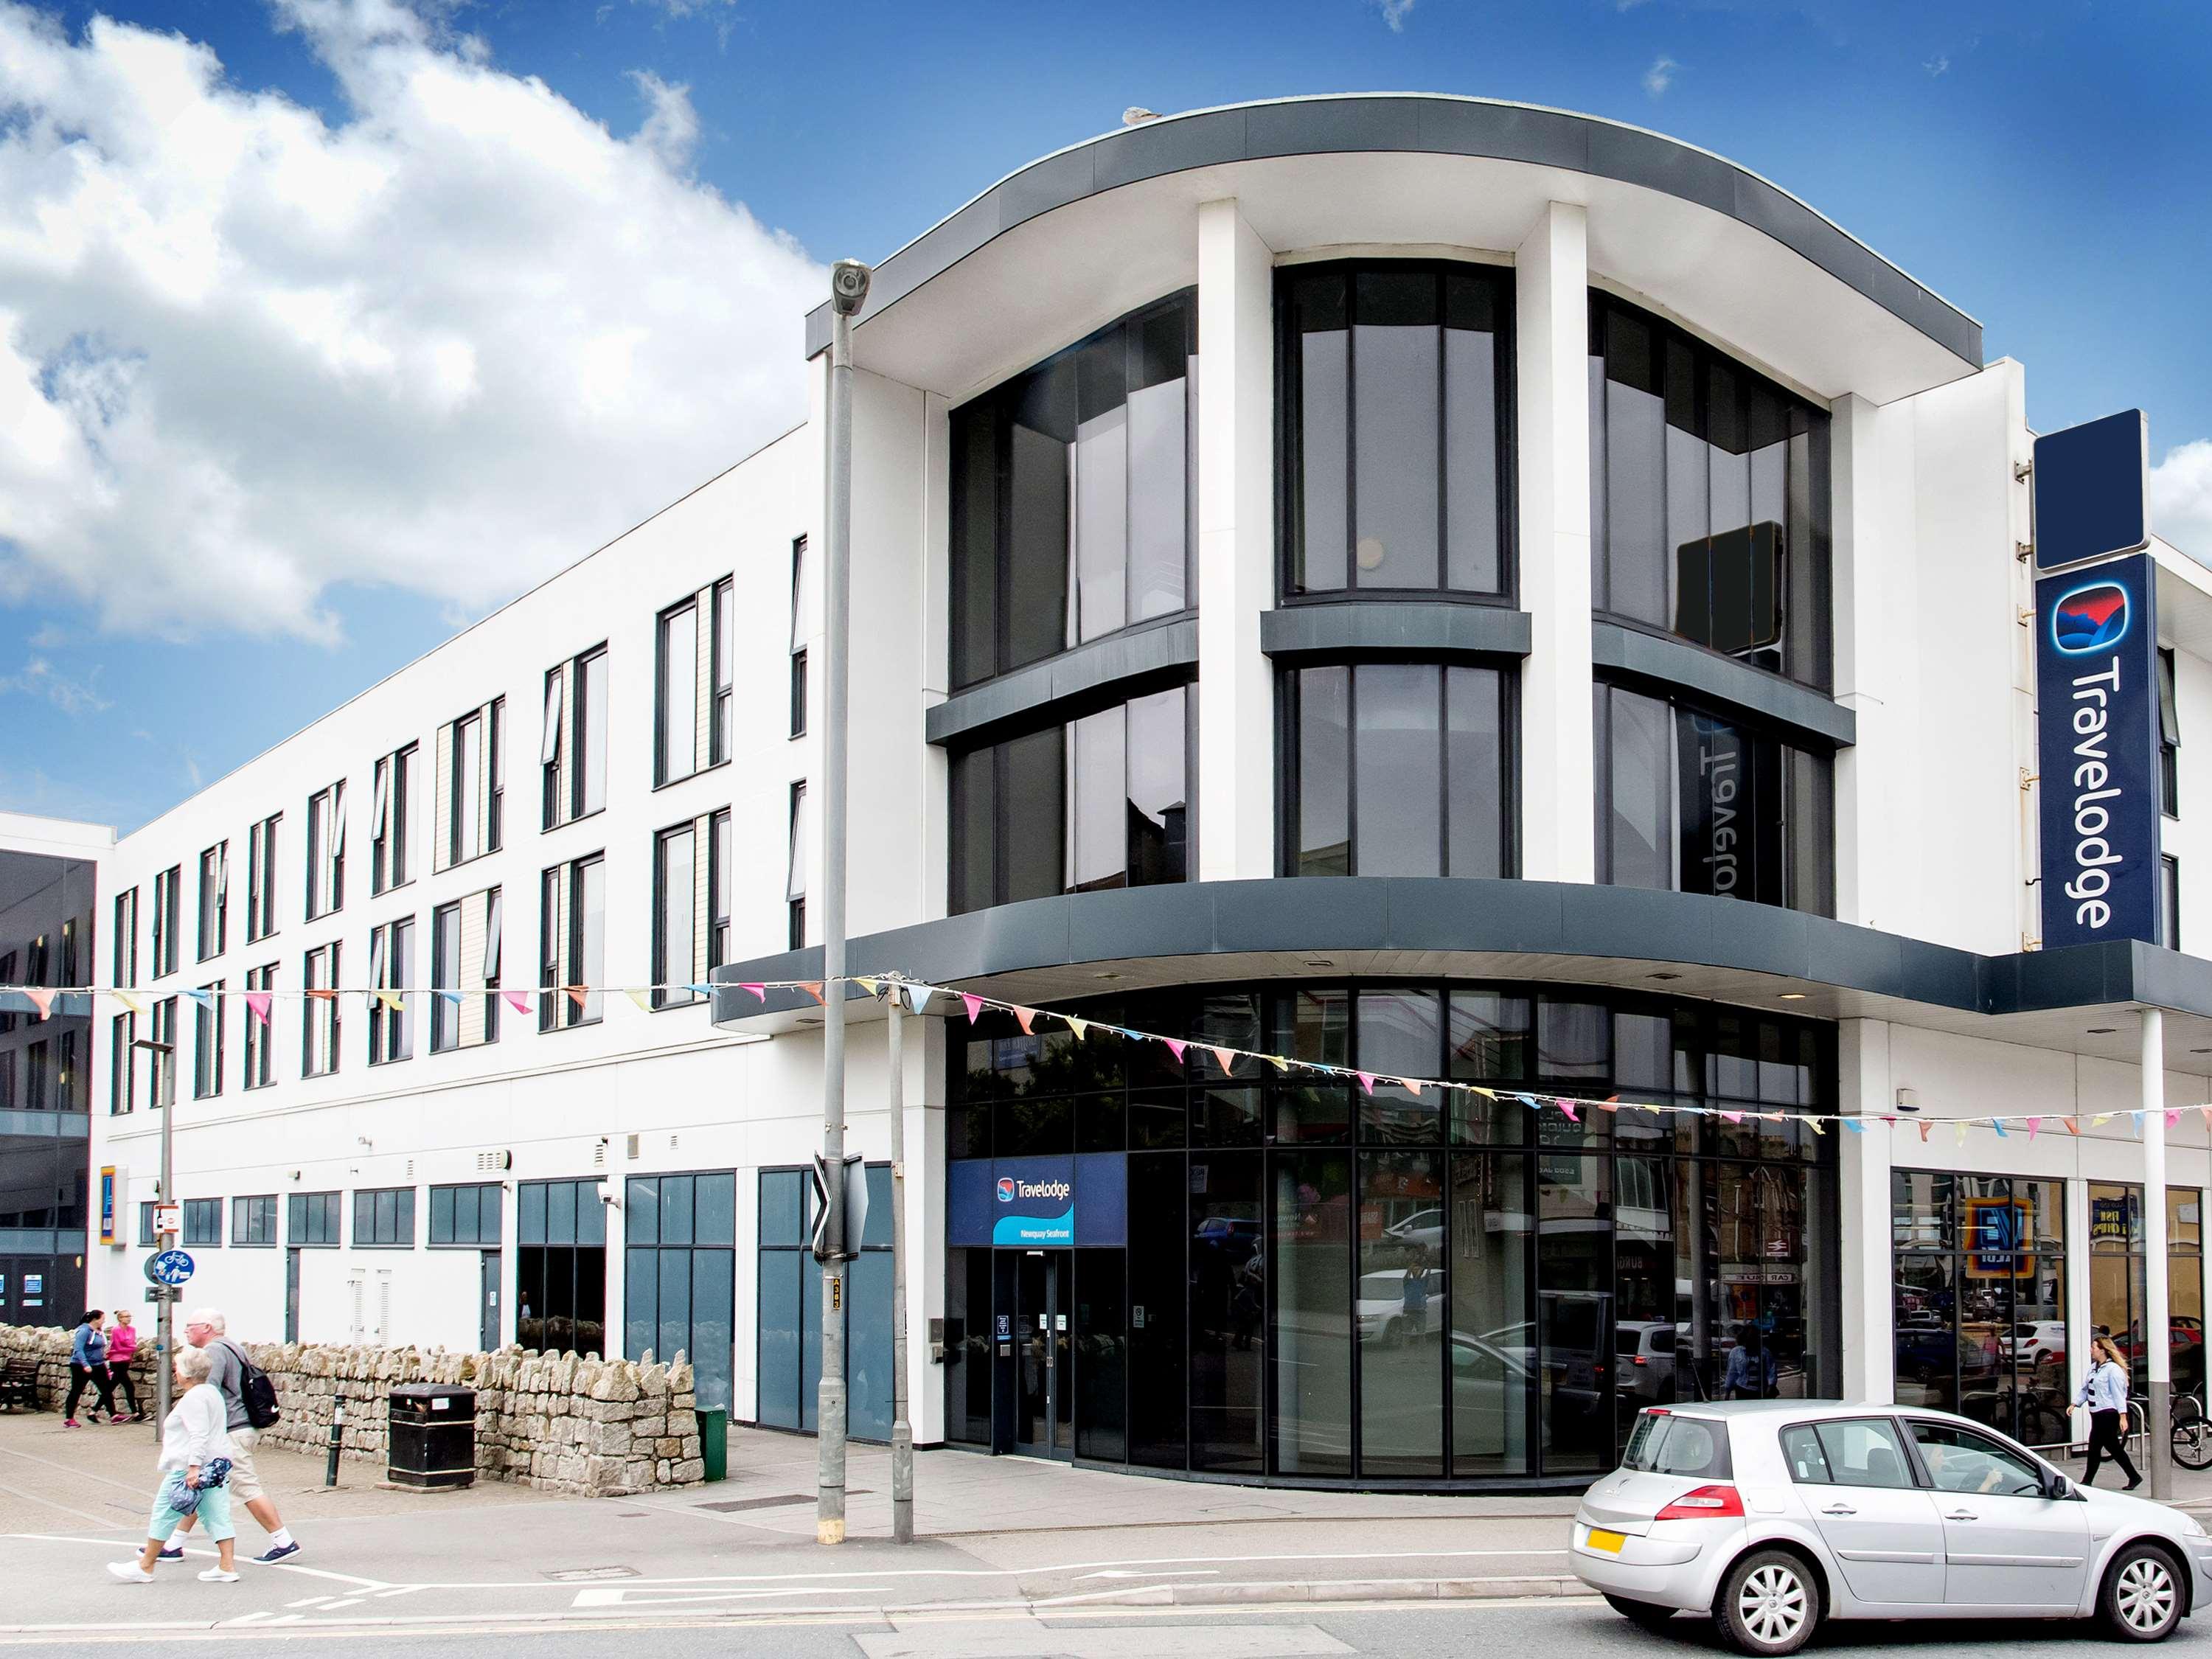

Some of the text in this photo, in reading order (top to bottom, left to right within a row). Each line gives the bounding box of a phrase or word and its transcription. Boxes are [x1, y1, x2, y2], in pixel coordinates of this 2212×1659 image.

[2065, 656, 2123, 929] Travelodge
[1016, 1179, 1070, 1200] Travelodge
[1020, 1228, 1069, 1239] Newquay Seafront
